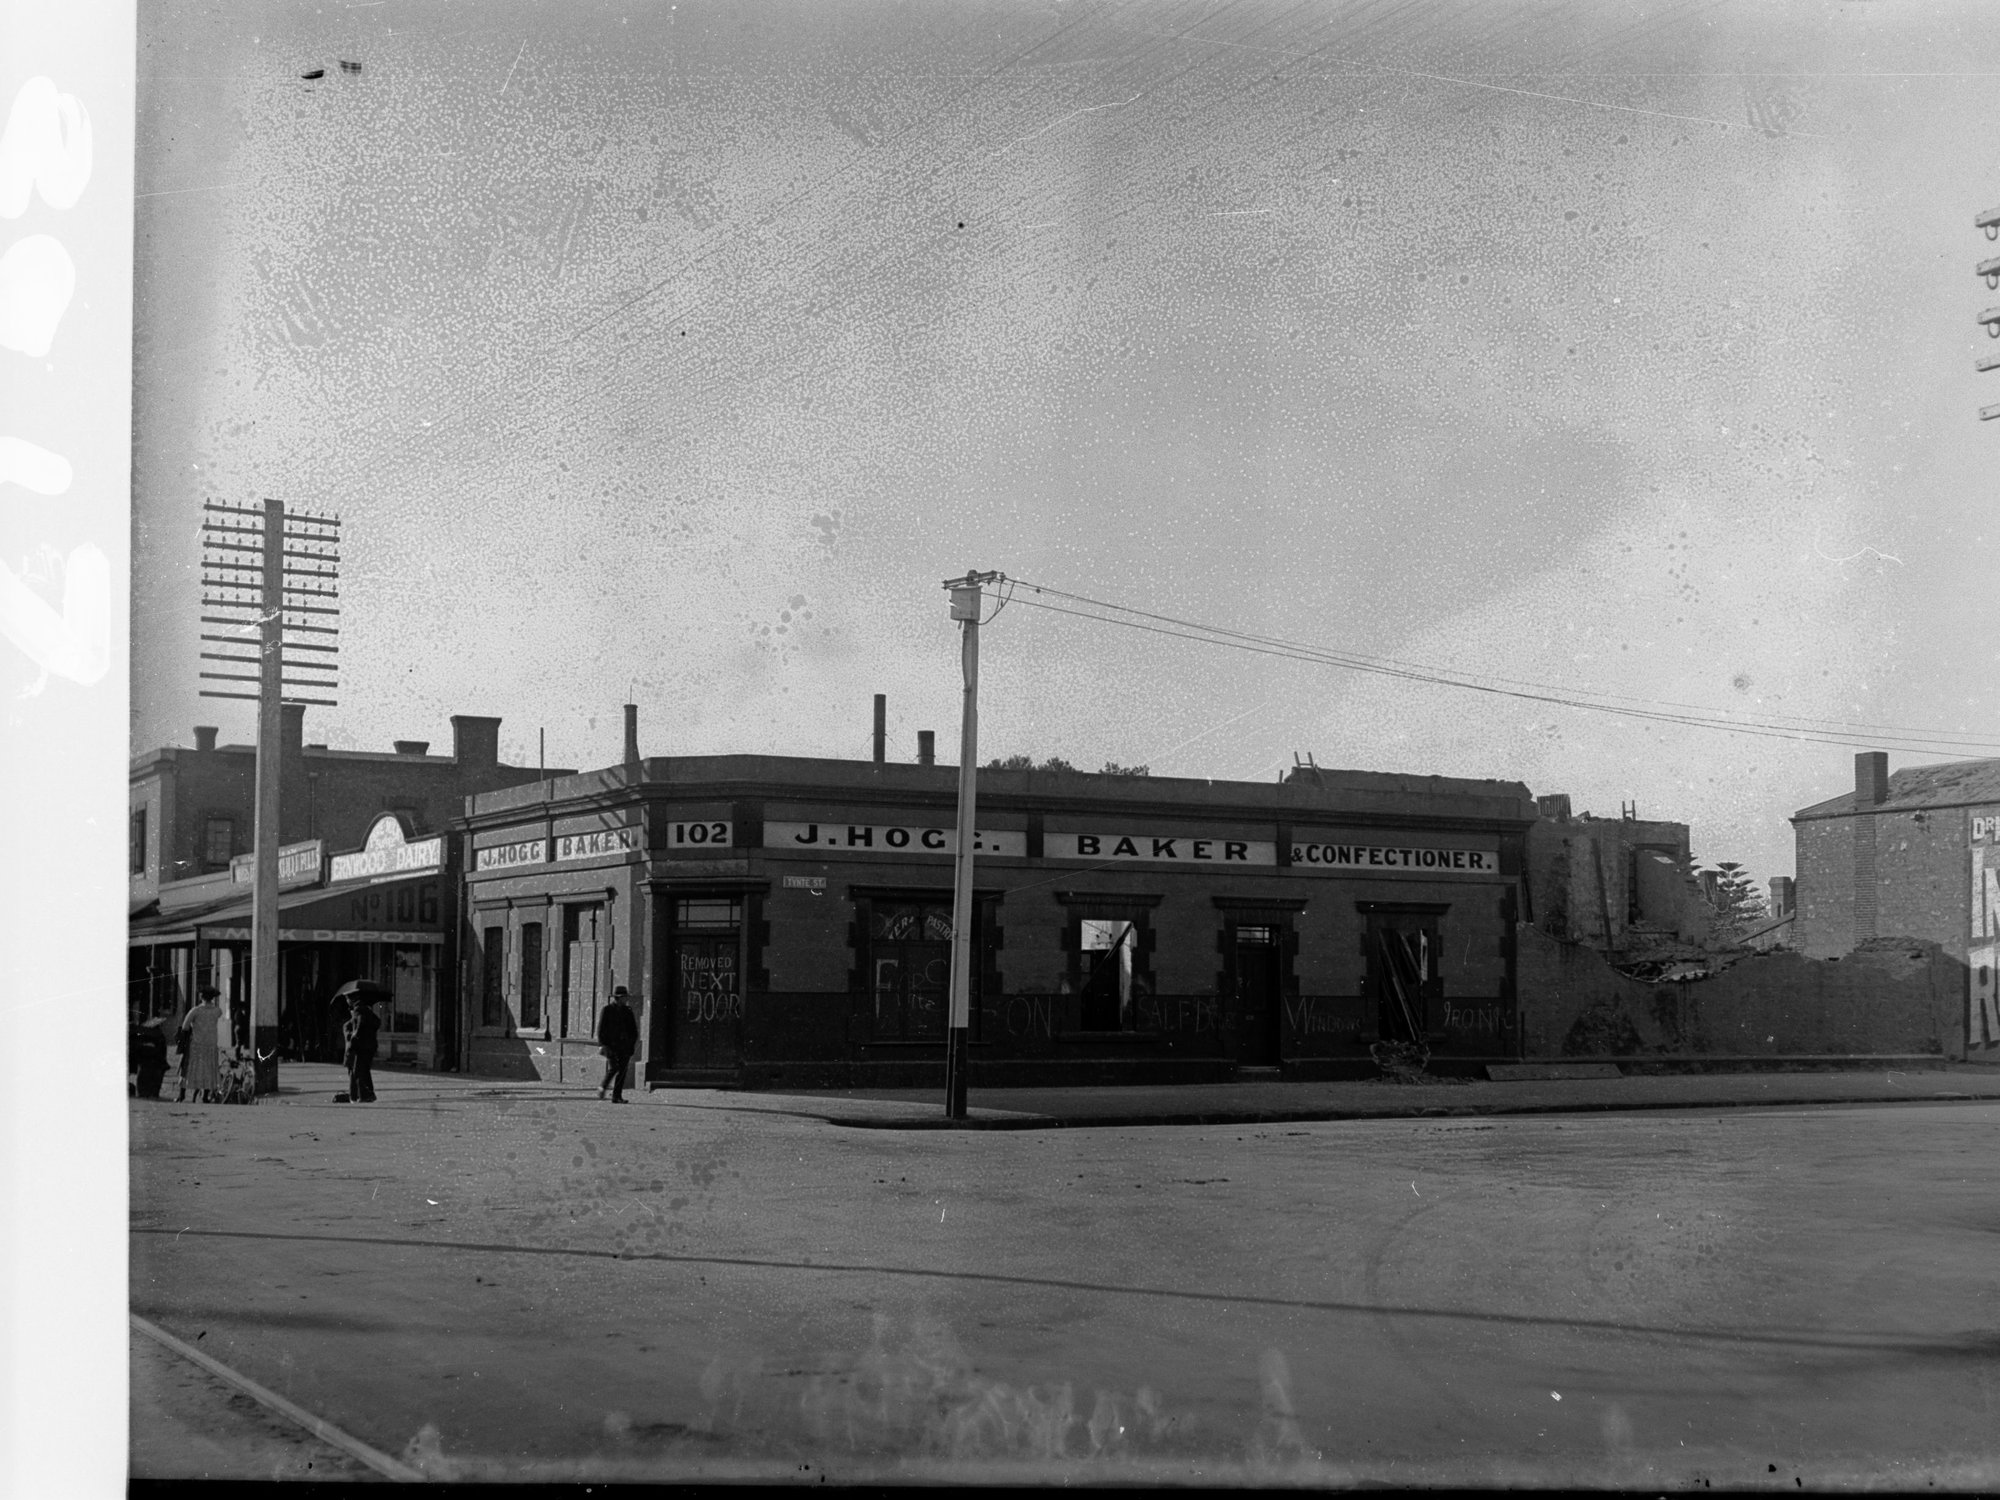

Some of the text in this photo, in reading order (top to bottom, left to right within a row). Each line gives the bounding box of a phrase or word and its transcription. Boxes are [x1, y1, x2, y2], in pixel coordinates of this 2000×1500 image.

[675, 822, 728, 844] 102
[1077, 835, 1248, 861] BAKER
[788, 878, 810, 887] TYNTE
[386, 884, 438, 923] 106
[224, 927, 427, 943] MK DEPOT
[681, 954, 732, 970] REMOVED
[683, 971, 736, 991] NEXT
[687, 990, 741, 1022] DOOR
[1007, 996, 1052, 1037] ON
